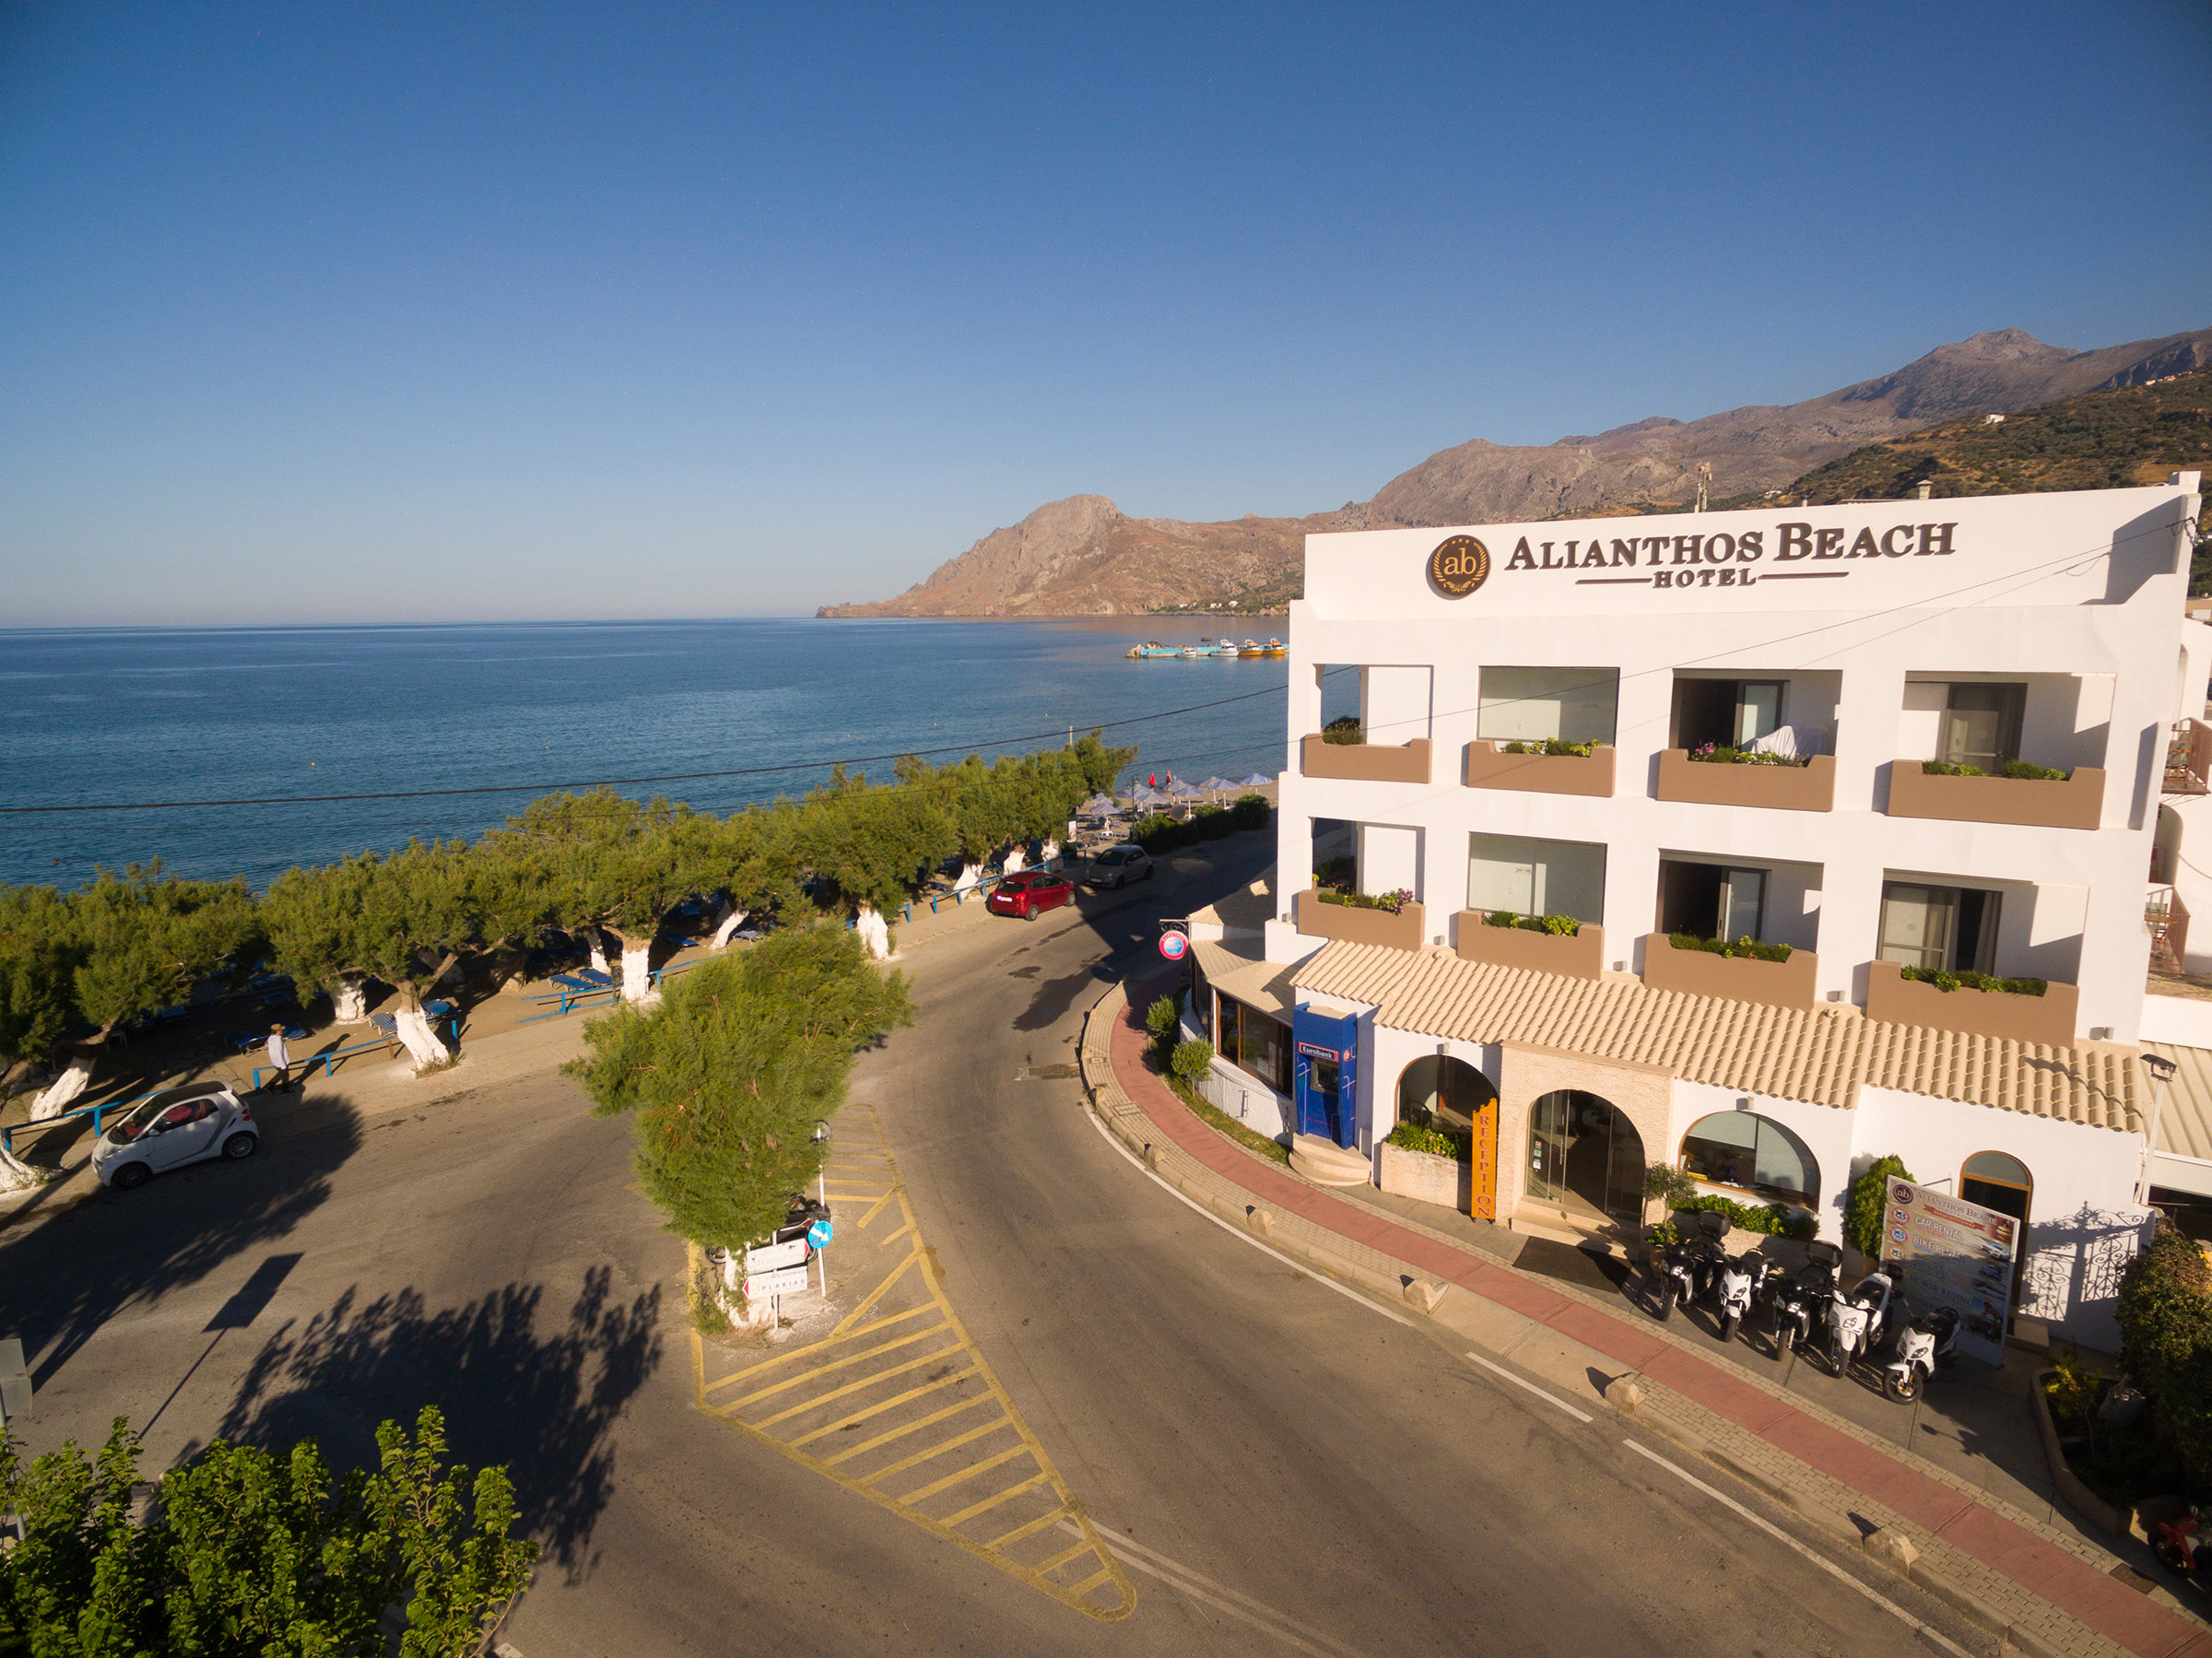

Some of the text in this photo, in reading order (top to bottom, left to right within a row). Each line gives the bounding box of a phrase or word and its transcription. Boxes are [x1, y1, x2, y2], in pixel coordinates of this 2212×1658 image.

[1504, 523, 1959, 570] ALIANTHOS BEACH
[1443, 547, 1477, 575] ab
[1652, 568, 1757, 588] HOTEL
[1302, 1045, 1333, 1060] Eurobank
[1477, 1115, 1491, 1217] RECEPTION
[1915, 1216, 1932, 1229] CAR
[1934, 1223, 1963, 1240] RENTAL
[1913, 1236, 1933, 1251] BIKE
[761, 1277, 805, 1291] PLAKIAS
